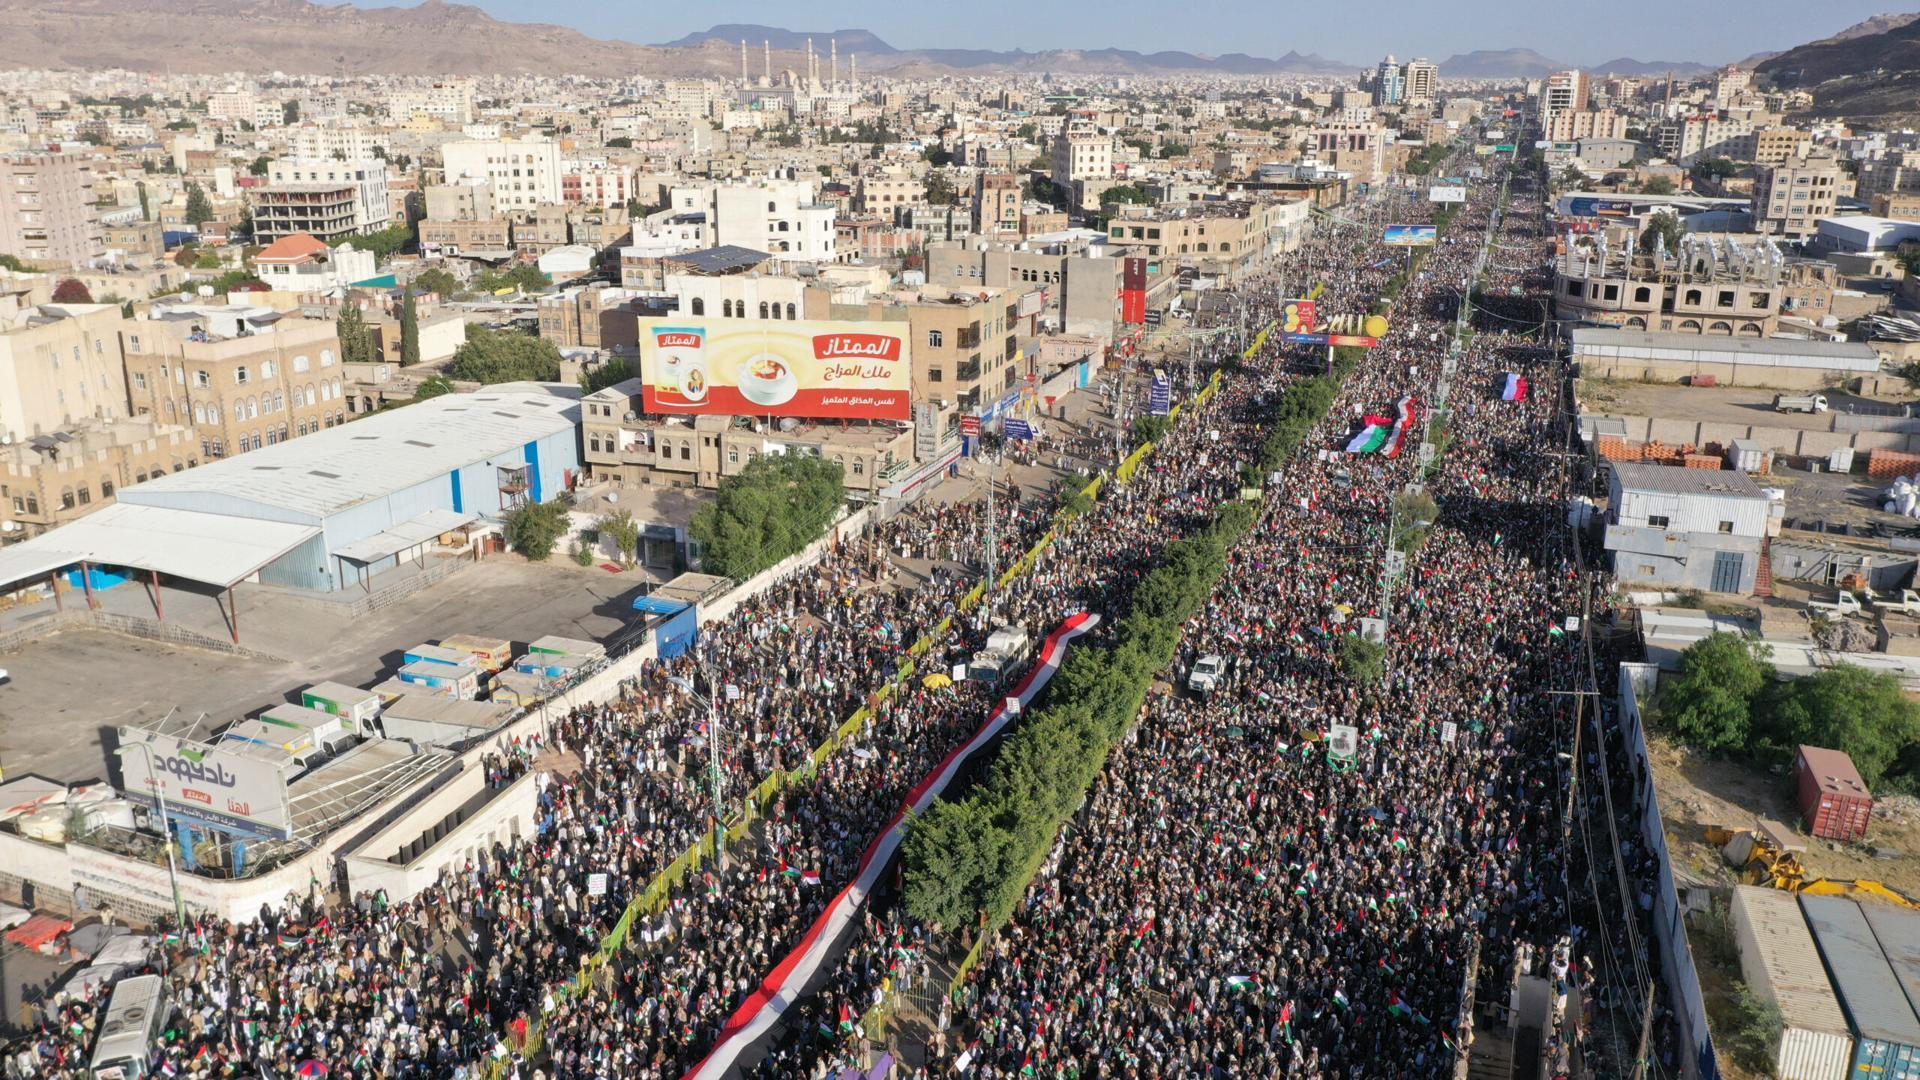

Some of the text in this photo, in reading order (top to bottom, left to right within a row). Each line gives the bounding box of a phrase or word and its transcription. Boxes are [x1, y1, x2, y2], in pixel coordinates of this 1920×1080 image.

[662, 335, 696, 346] الممتاز
[822, 337, 891, 356] الممتاز
[823, 363, 892, 381] ملك المزاج
[820, 396, 896, 407] نفس المذاق المتميز
